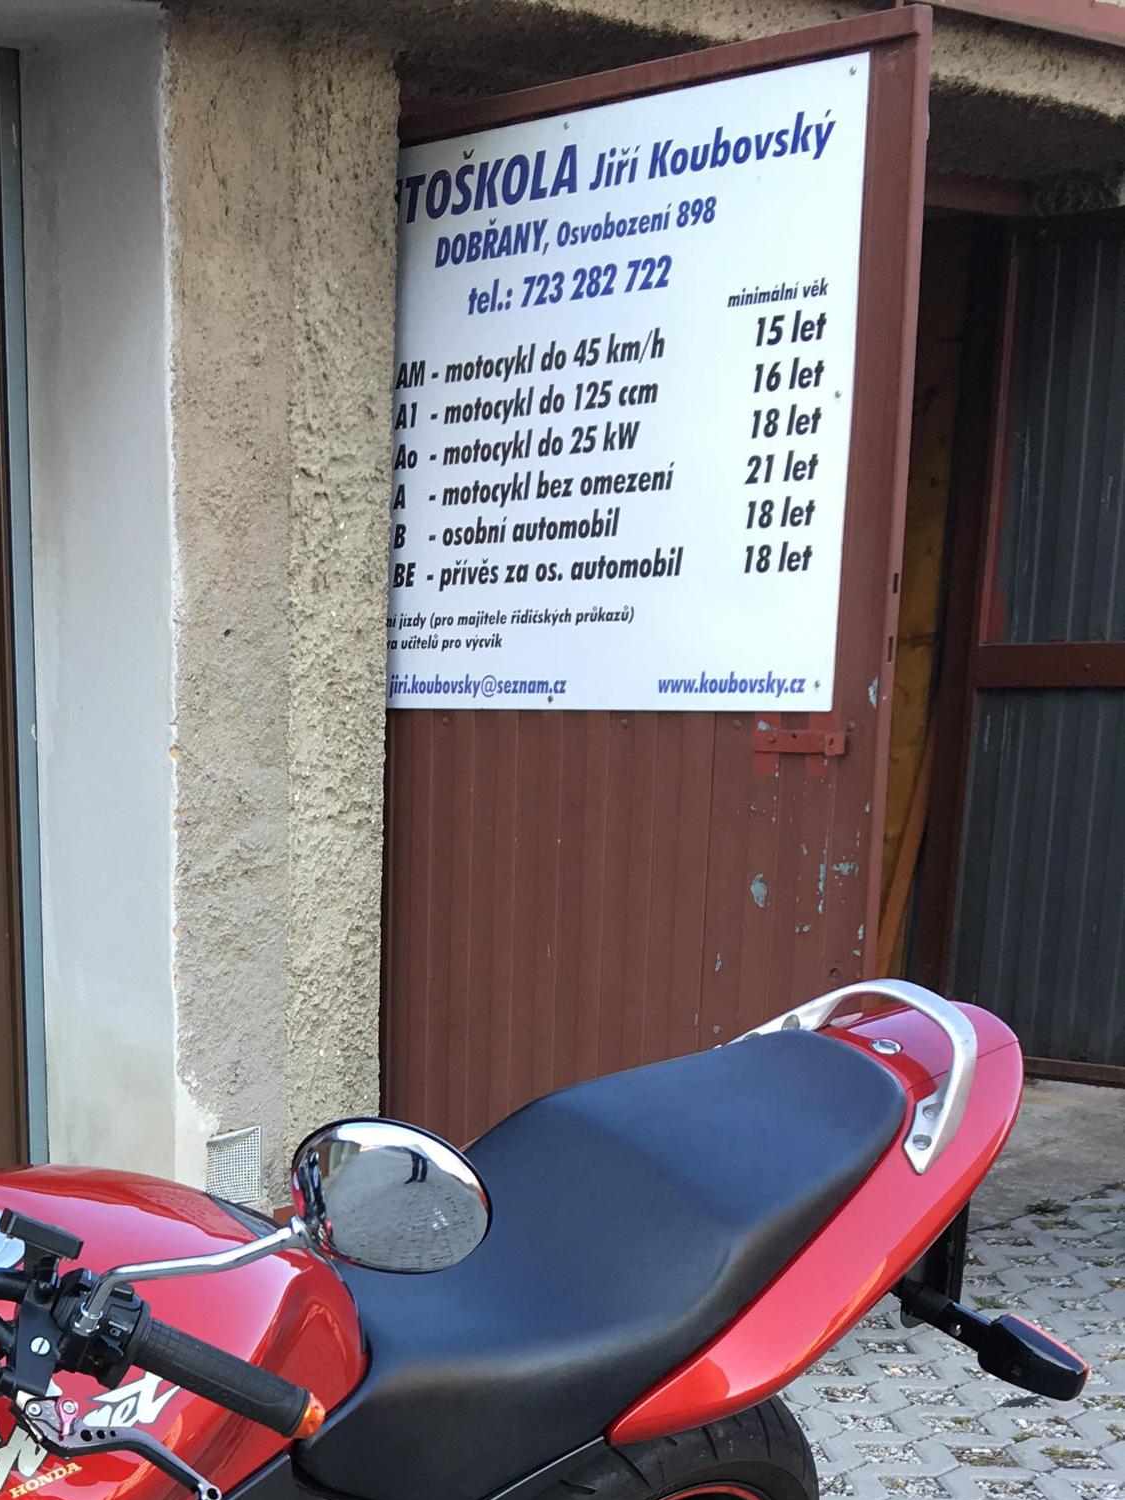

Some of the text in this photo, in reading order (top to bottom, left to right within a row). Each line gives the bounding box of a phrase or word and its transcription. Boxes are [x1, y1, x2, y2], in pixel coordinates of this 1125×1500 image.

[589, 145, 640, 190] Jiří
[648, 109, 836, 179] Koubovský
[435, 196, 716, 268] DOBŘANY, Osvobození 898
[468, 255, 672, 315] tel.: 723 282 722
[728, 278, 828, 307] minimální věk
[756, 310, 827, 347] 15 let
[395, 360, 426, 390] AM
[445, 343, 536, 383] motocykl
[541, 340, 567, 372] do
[573, 337, 601, 367] 45
[606, 327, 665, 364] km/h
[754, 357, 824, 393] 16 let
[394, 402, 417, 430] A1
[444, 386, 534, 425] motocykl
[539, 384, 565, 415] do
[575, 380, 613, 411] 125
[619, 383, 658, 407] ccm
[751, 405, 822, 439] 18 let
[443, 429, 533, 467] motocykl
[538, 427, 563, 457] do
[569, 425, 598, 454] 25
[603, 421, 640, 451] kW
[744, 450, 819, 484] 21 let
[393, 484, 406, 510] A
[442, 471, 532, 508] motocykl
[536, 470, 574, 499] bez
[580, 462, 674, 496] omezení
[393, 523, 407, 549] B
[443, 516, 507, 546] osobní
[512, 507, 620, 542] automobil
[747, 496, 815, 529] 18 let
[393, 562, 416, 589] BE
[439, 558, 499, 592] přívěs
[504, 564, 529, 583] za
[535, 562, 563, 582] os.
[571, 546, 683, 581] automobil
[744, 541, 812, 573] 18 let
[430, 612, 454, 629] (pro
[457, 610, 507, 628] majitele
[575, 605, 634, 626] průkazů)
[401, 634, 438, 650] učitelů
[441, 639, 461, 652] pro
[466, 633, 502, 651] výcvik
[659, 671, 805, 697] www.koubovsky.cz
[8, 1461, 83, 1499] HONDA
